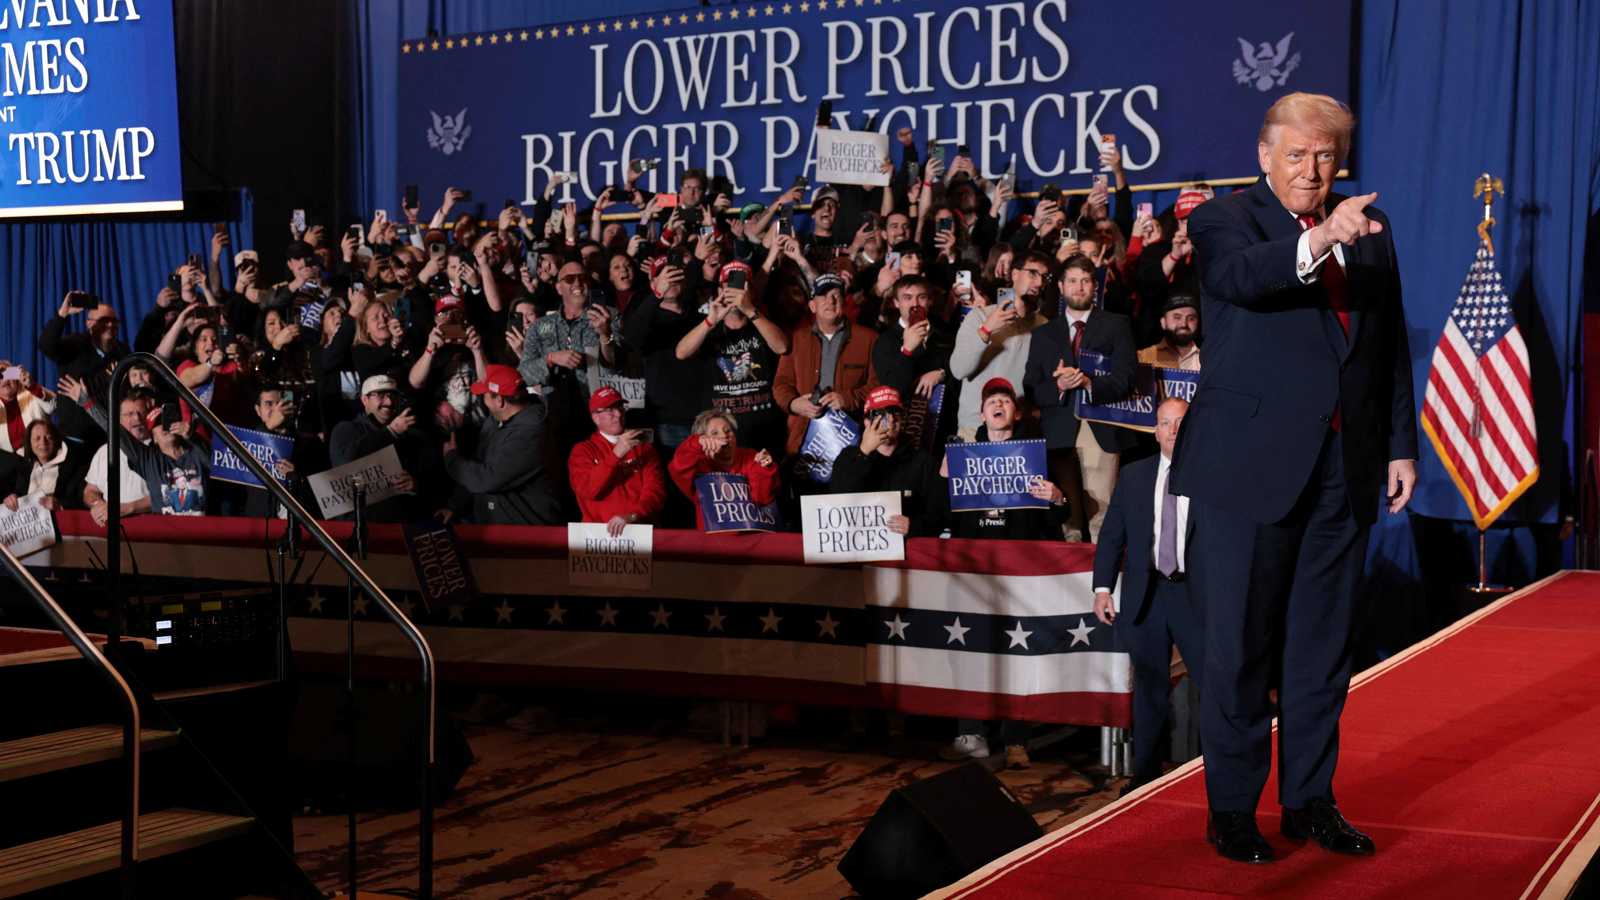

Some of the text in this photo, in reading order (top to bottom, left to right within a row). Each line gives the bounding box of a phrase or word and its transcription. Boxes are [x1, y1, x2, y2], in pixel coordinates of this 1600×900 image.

[1, 37, 88, 97] MES
[590, 0, 1070, 119] LOWER PRICES
[9, 127, 155, 186] TRUMP
[831, 143, 877, 158] BIGGER
[520, 120, 746, 206] BIGGER
[819, 156, 882, 174] PAYCHECK
[965, 455, 1028, 476] BIGGER
[708, 482, 750, 502] LOW
[816, 504, 887, 530] LOWER
[585, 537, 637, 556] BIGGER
[817, 528, 890, 553] PRICES
[570, 555, 650, 575] PAYCHECKS
